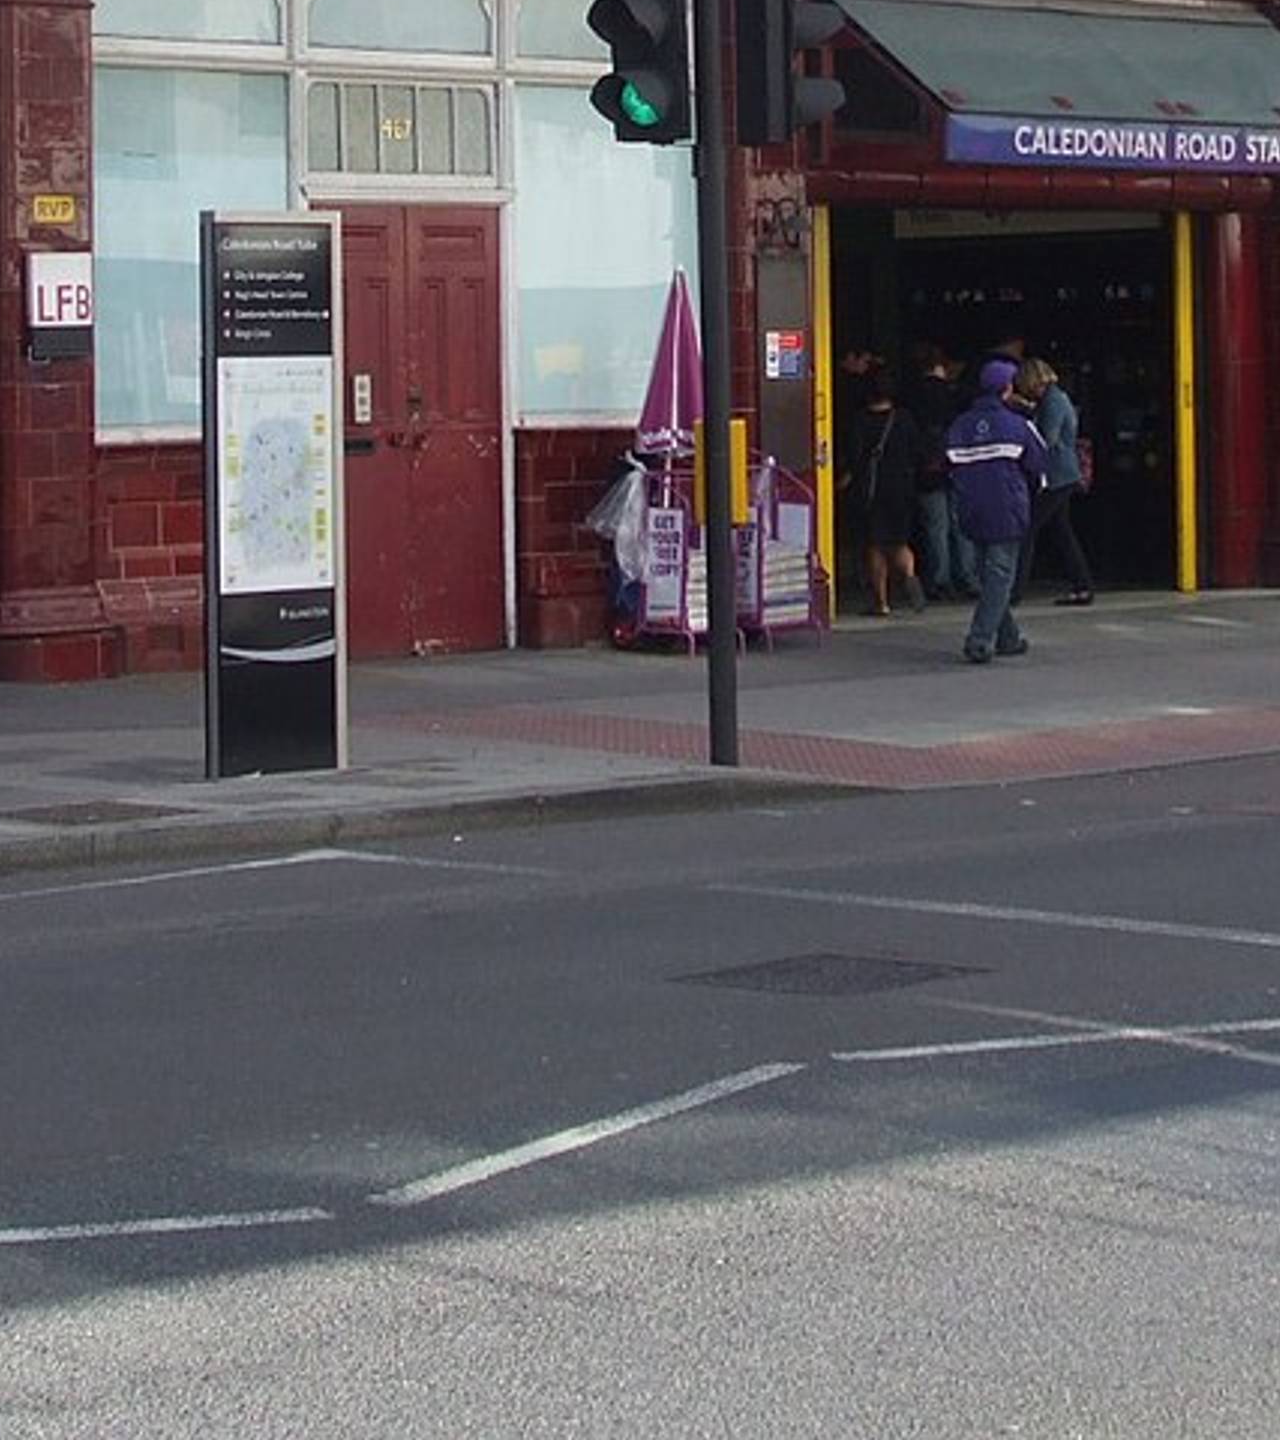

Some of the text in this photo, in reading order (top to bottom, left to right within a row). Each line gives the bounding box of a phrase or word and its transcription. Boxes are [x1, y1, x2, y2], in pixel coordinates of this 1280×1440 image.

[1014, 125, 1167, 160] CALEDONIAN
[1175, 132, 1237, 162] ROAD
[36, 200, 72, 218] RVP
[37, 284, 90, 322] LFB
